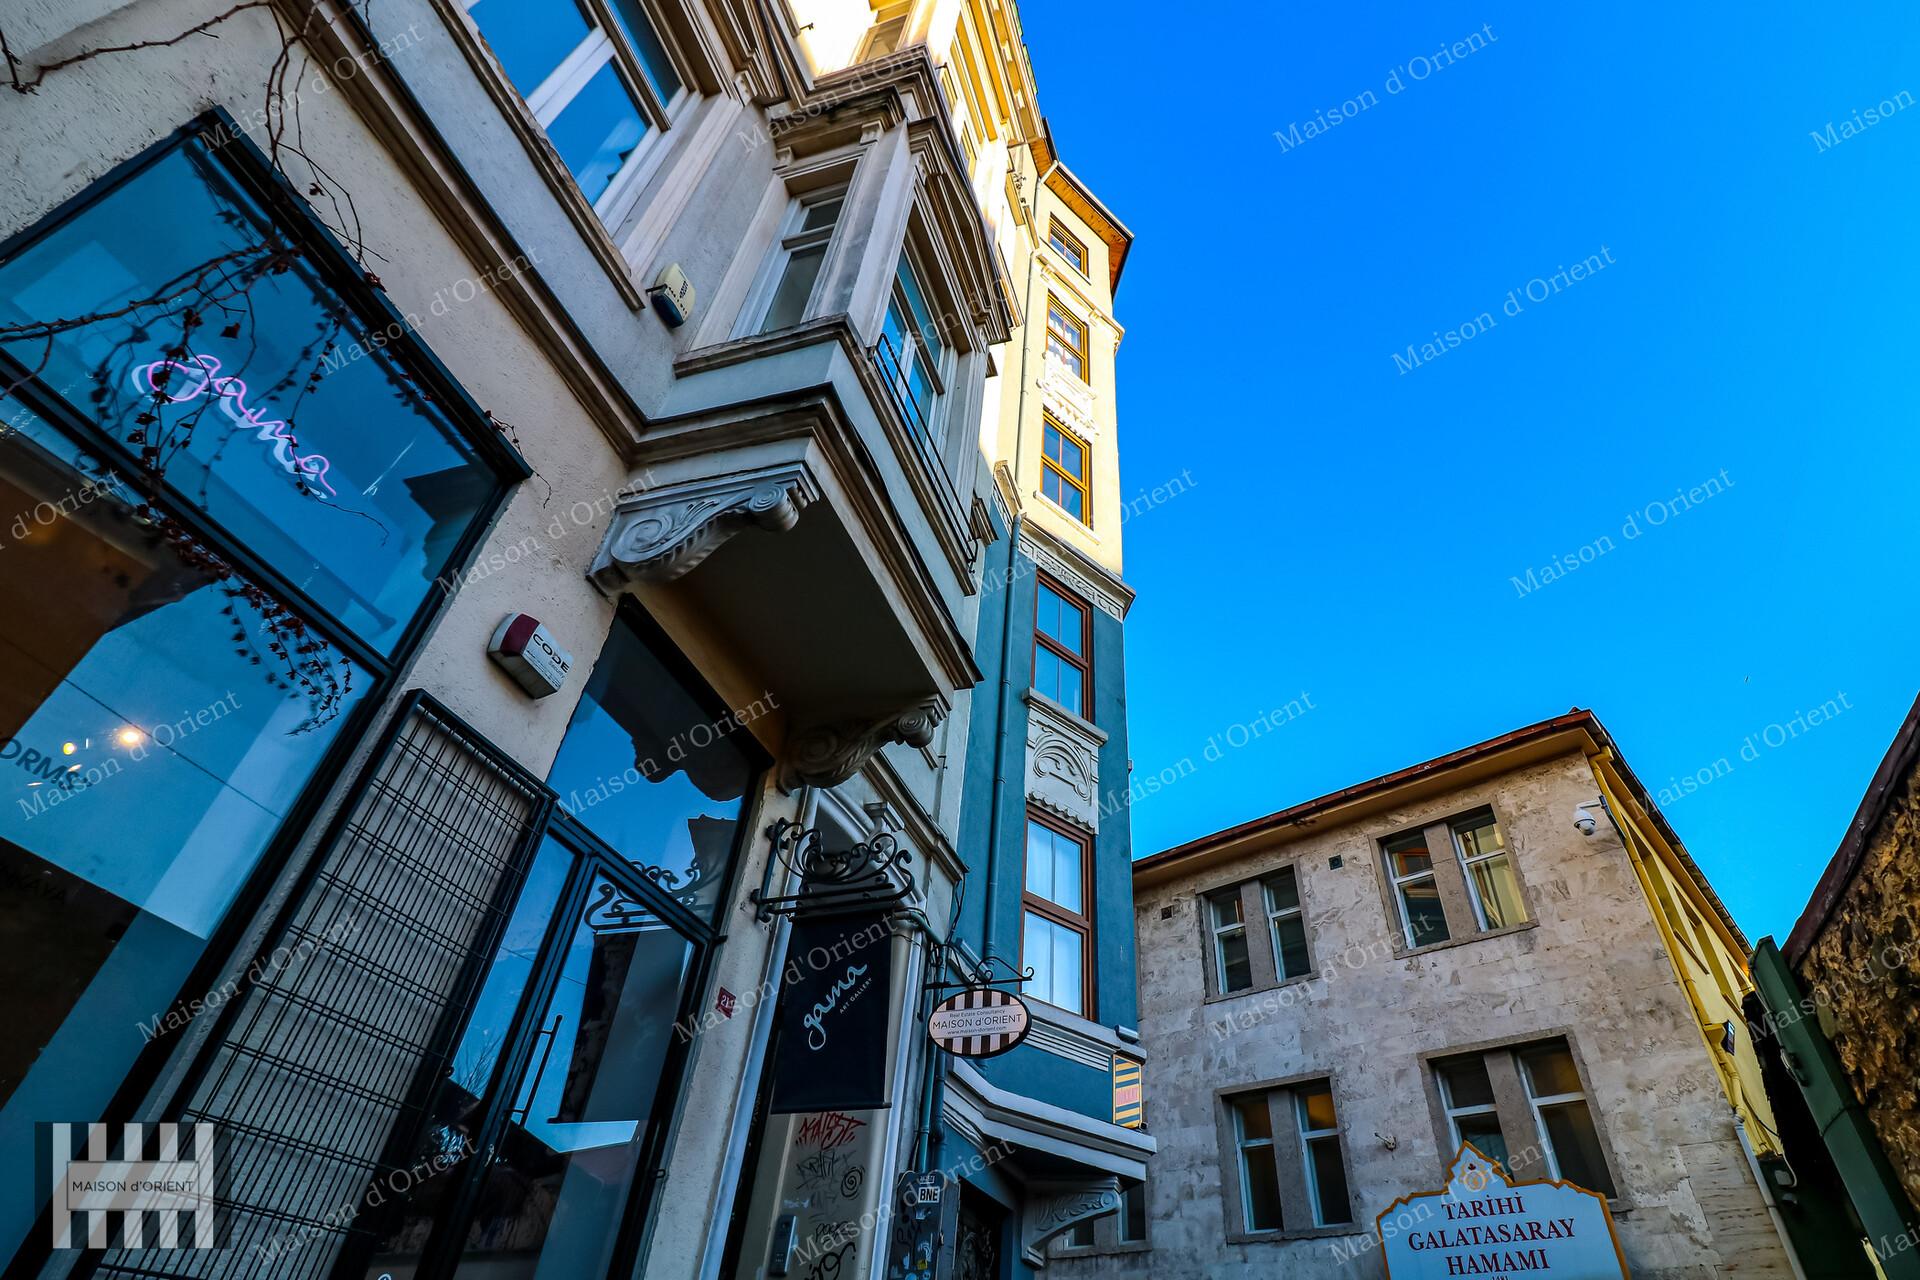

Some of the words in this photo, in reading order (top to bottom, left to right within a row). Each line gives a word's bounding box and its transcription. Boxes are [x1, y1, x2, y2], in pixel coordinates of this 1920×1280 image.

[532, 633, 570, 673] CODE
[850, 977, 873, 1002] GALLERY
[803, 963, 868, 1050] gama
[932, 1019, 973, 1030] MAISON
[975, 1013, 1022, 1027] d'ORIENT
[919, 1188, 938, 1201] BNE
[1408, 1218, 1576, 1251] GALATASARAY
[1446, 1249, 1552, 1276] HAMAMI
